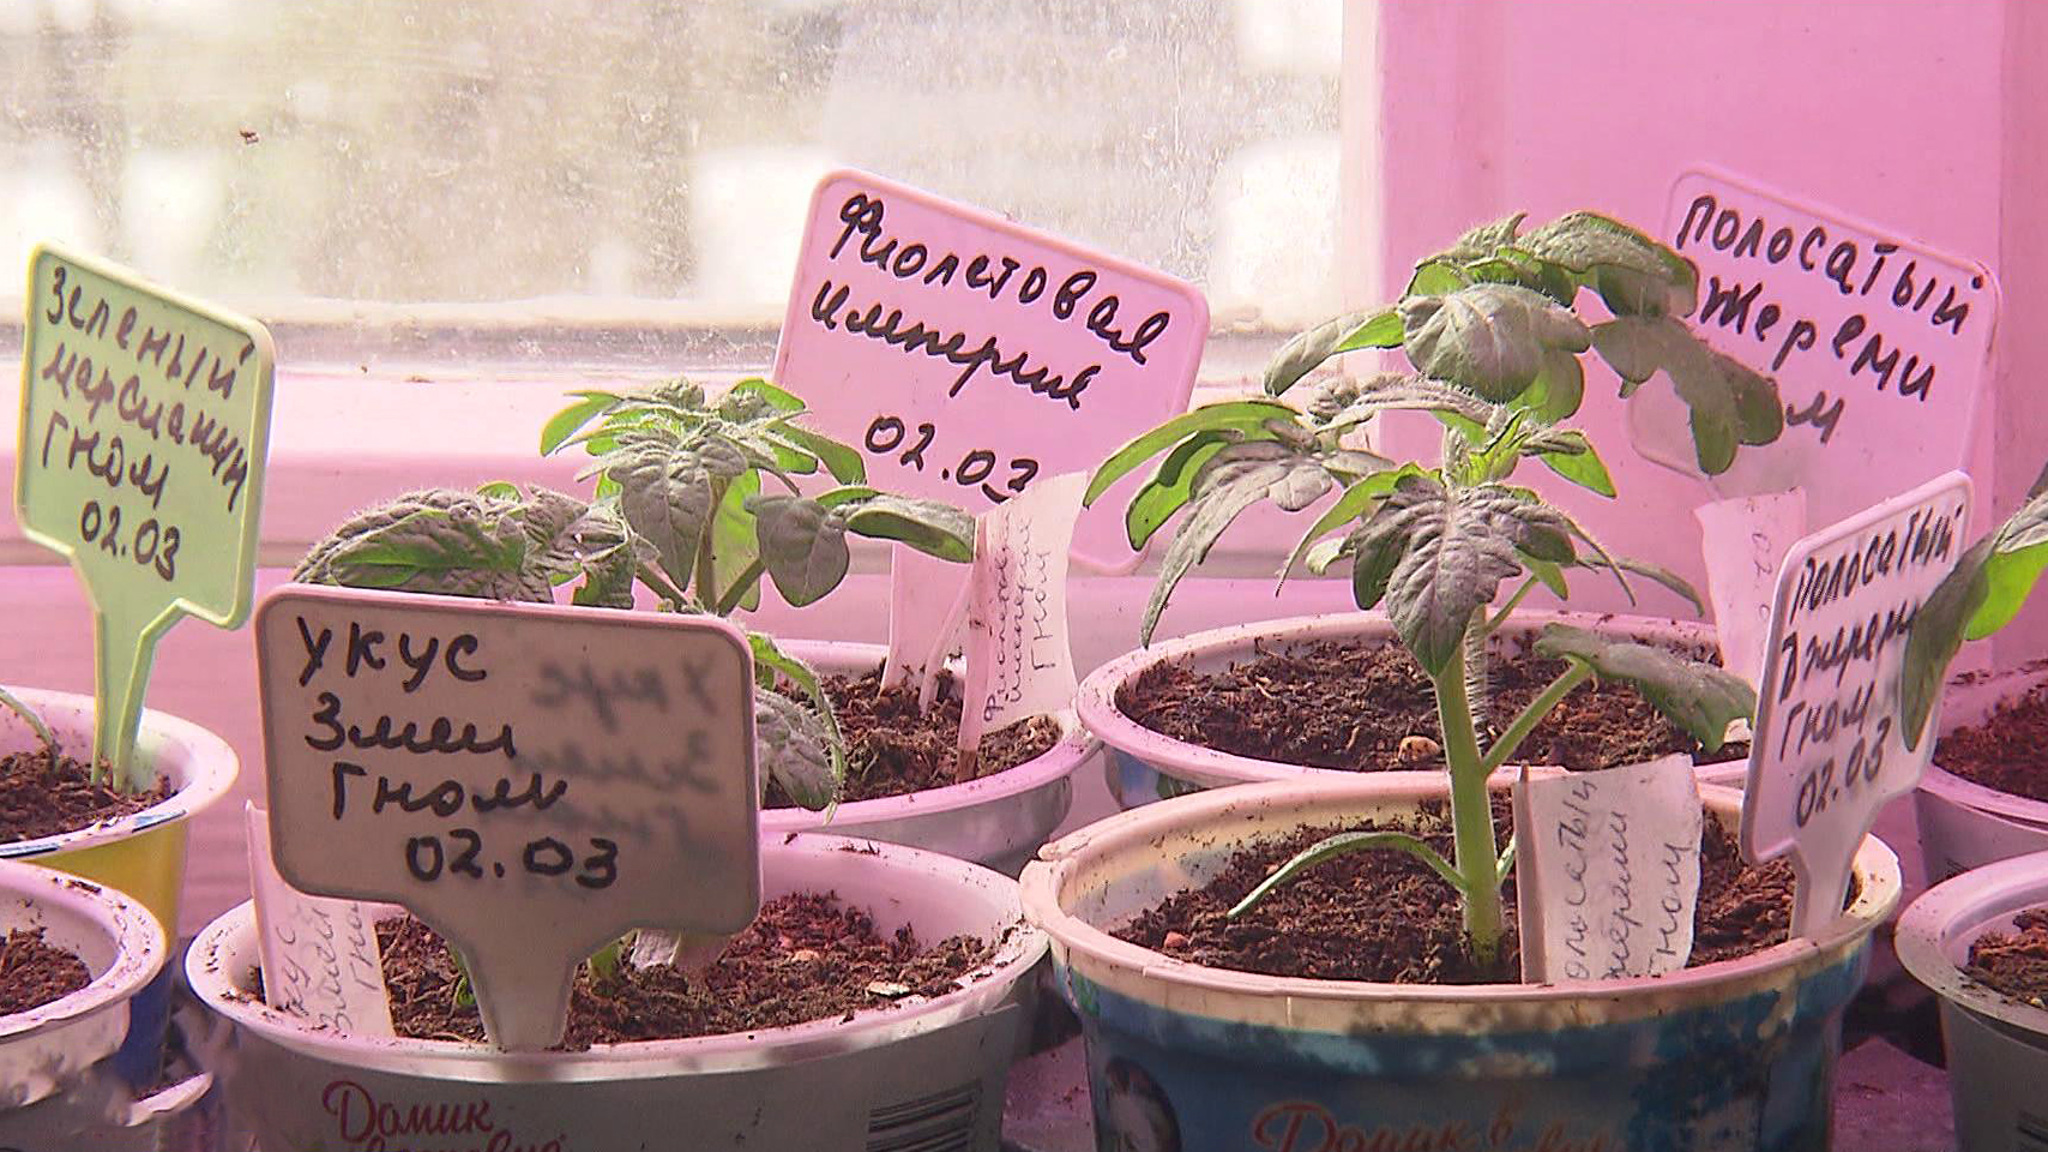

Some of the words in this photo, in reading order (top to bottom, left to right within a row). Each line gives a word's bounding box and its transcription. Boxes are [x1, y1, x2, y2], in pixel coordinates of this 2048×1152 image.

[830, 192, 1170, 366] Фиолетовая
[46, 265, 256, 401] Зеленый
[811, 279, 1101, 410] Империя
[1699, 275, 1936, 402] жереми
[41, 410, 170, 511] Гном
[864, 415, 1039, 504] 02.03
[80, 500, 182, 583] 02.03
[1779, 680, 1876, 763] Гном
[331, 761, 568, 820] Гном
[1796, 715, 1892, 829] 02.03
[404, 828, 619, 889] 02.03
[348, 902, 381, 992] Гно
[322, 1080, 496, 1144] Домик
